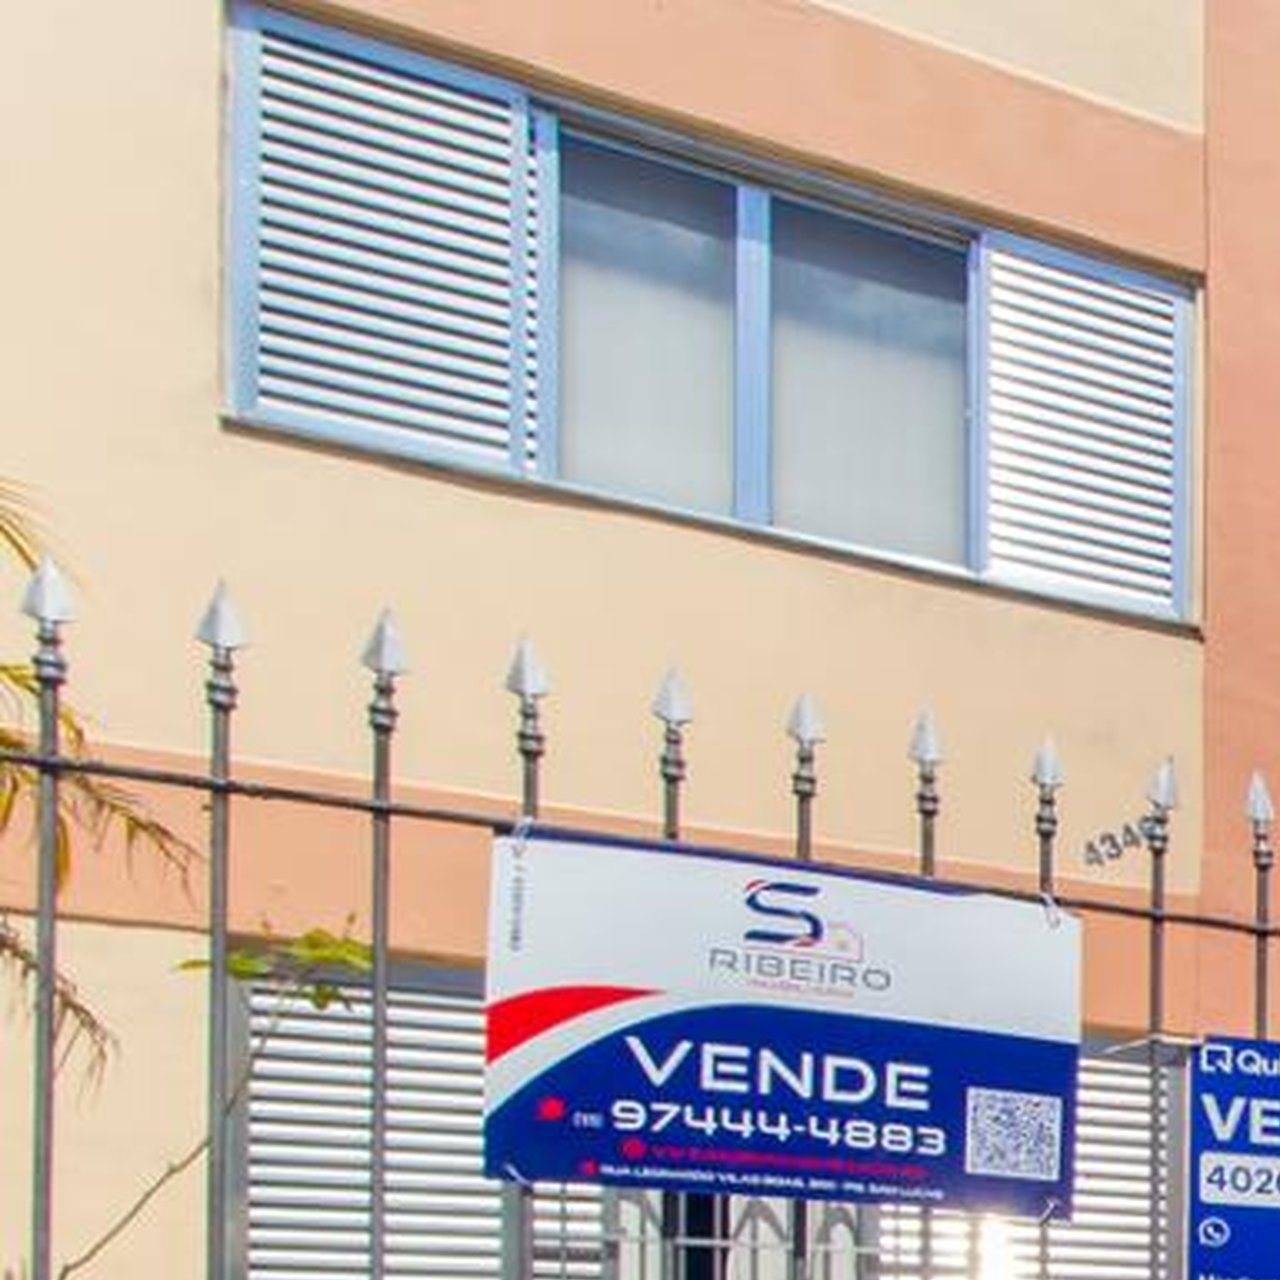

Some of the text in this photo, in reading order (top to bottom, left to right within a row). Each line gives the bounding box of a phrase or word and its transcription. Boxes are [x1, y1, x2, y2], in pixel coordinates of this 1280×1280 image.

[708, 947, 893, 993] RIBEIRO
[624, 1035, 933, 1111] VENDE
[611, 1099, 948, 1157] 97444-4883
